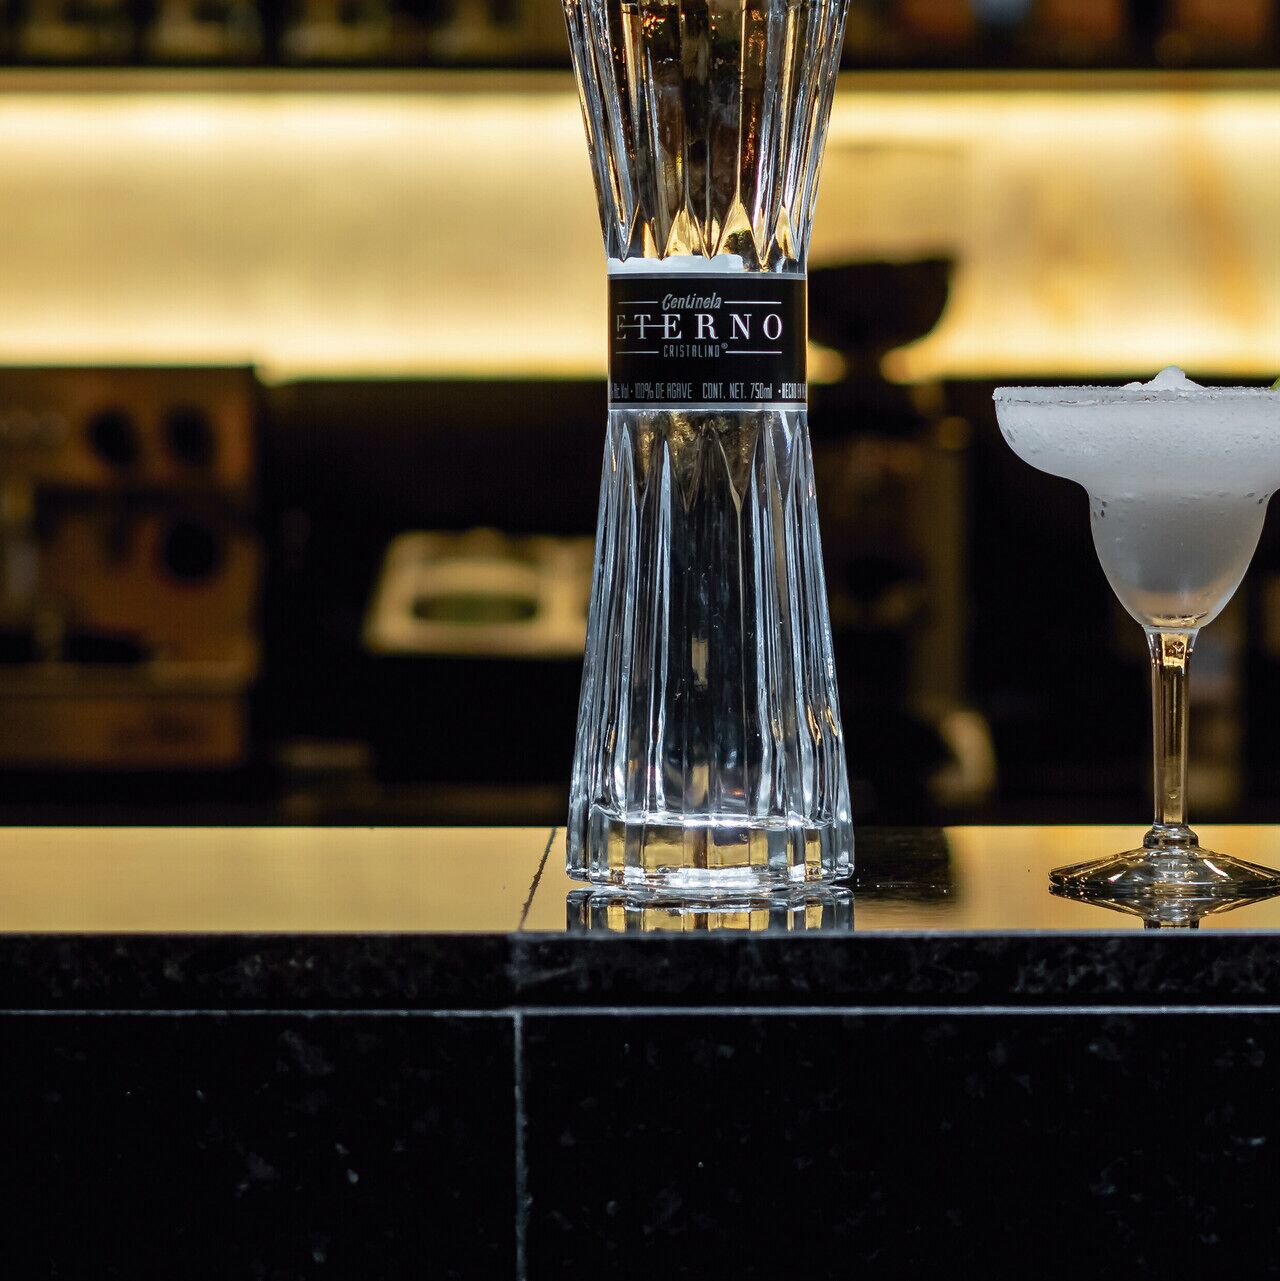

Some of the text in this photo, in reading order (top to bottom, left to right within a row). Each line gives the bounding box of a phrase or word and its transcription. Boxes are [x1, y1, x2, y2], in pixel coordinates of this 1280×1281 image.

[662, 292, 721, 311] Centinela
[616, 313, 783, 340] ETERNO
[635, 382, 654, 399] 100%
[655, 382, 665, 399] DE
[666, 382, 693, 399] AGAVE
[702, 382, 726, 399] CONT.
[729, 382, 747, 399] NET.
[750, 382, 772, 399] 750ml
